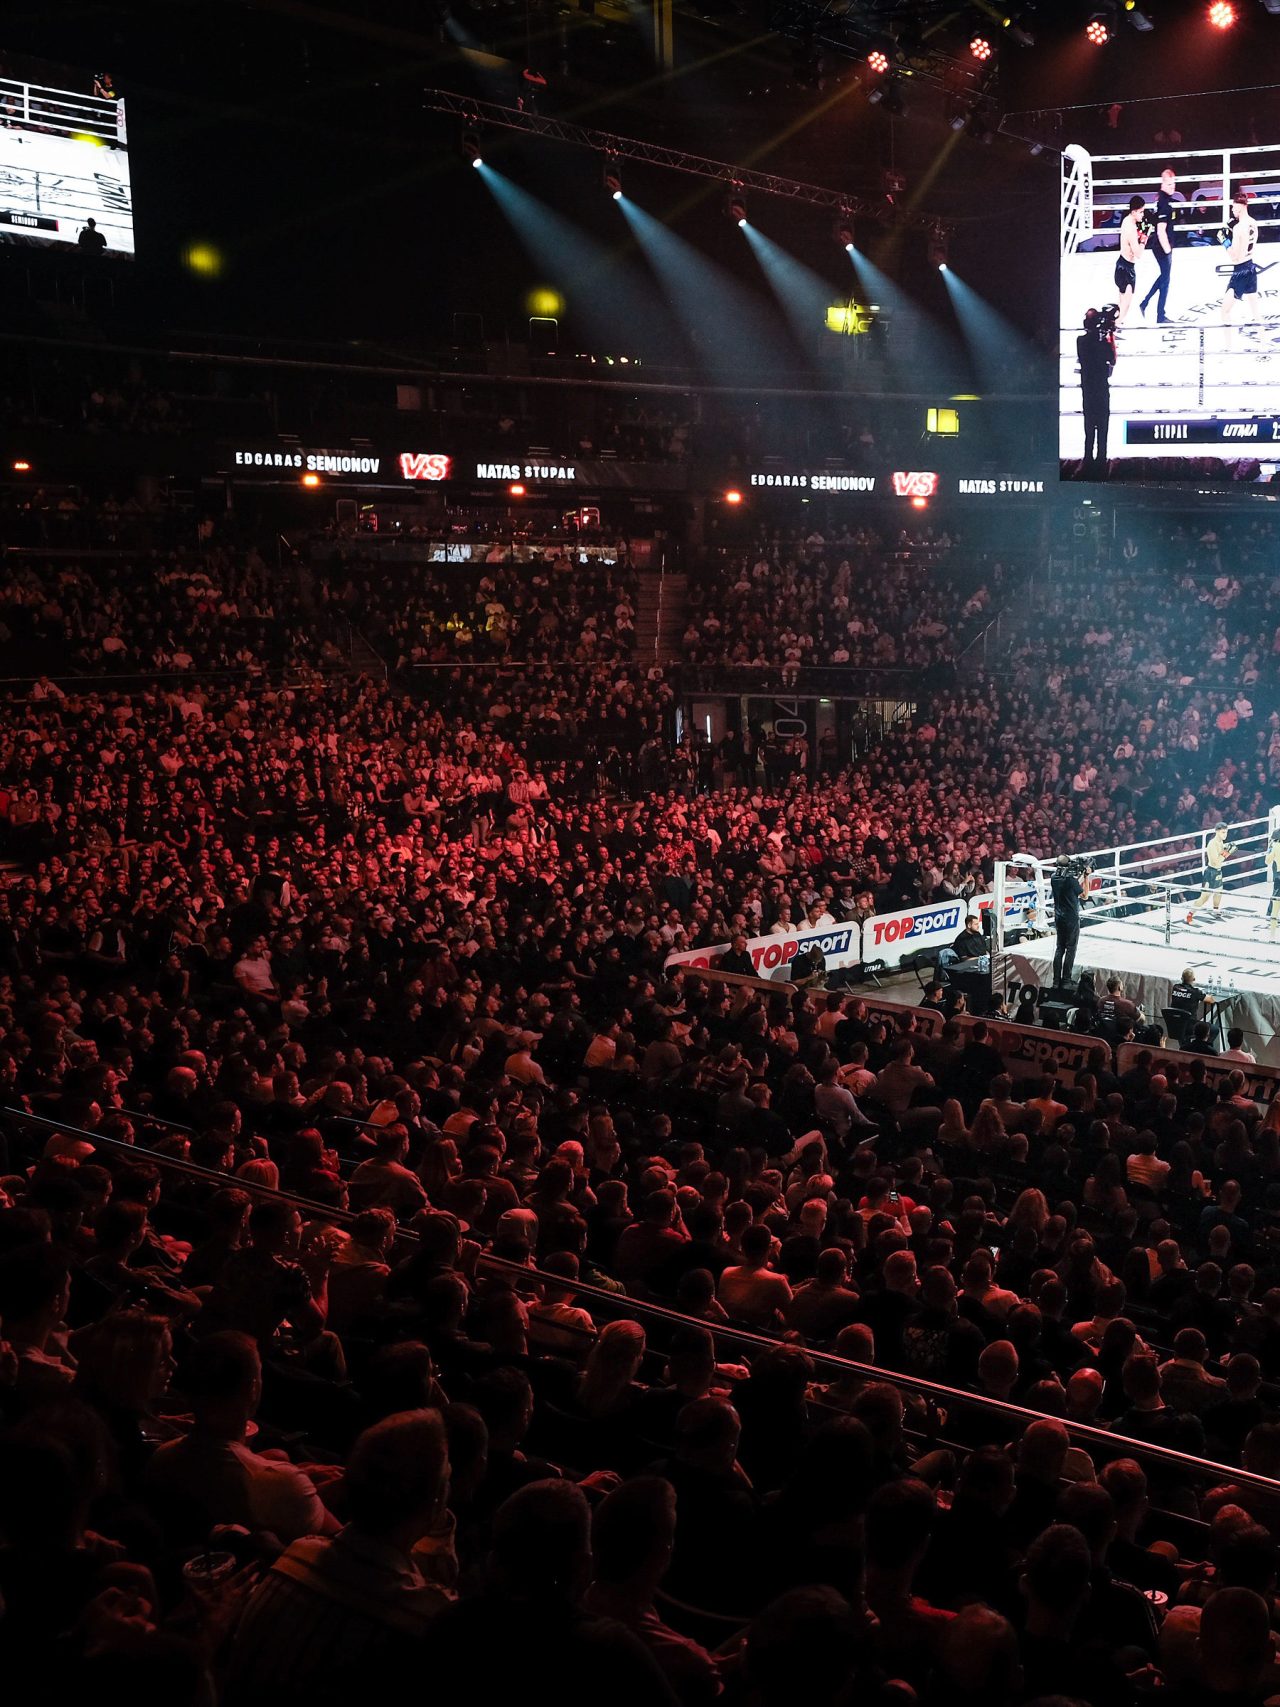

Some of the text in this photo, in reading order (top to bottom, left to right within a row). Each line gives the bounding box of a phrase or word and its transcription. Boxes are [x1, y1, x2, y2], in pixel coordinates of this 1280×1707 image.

[236, 452, 575, 481] EDGARAS SEMIONOV VS NATAS STUPAK
[751, 471, 1044, 497] EDGARAS SEMIONOV VS NATAS STUPAK
[873, 906, 959, 945] TOPsport
